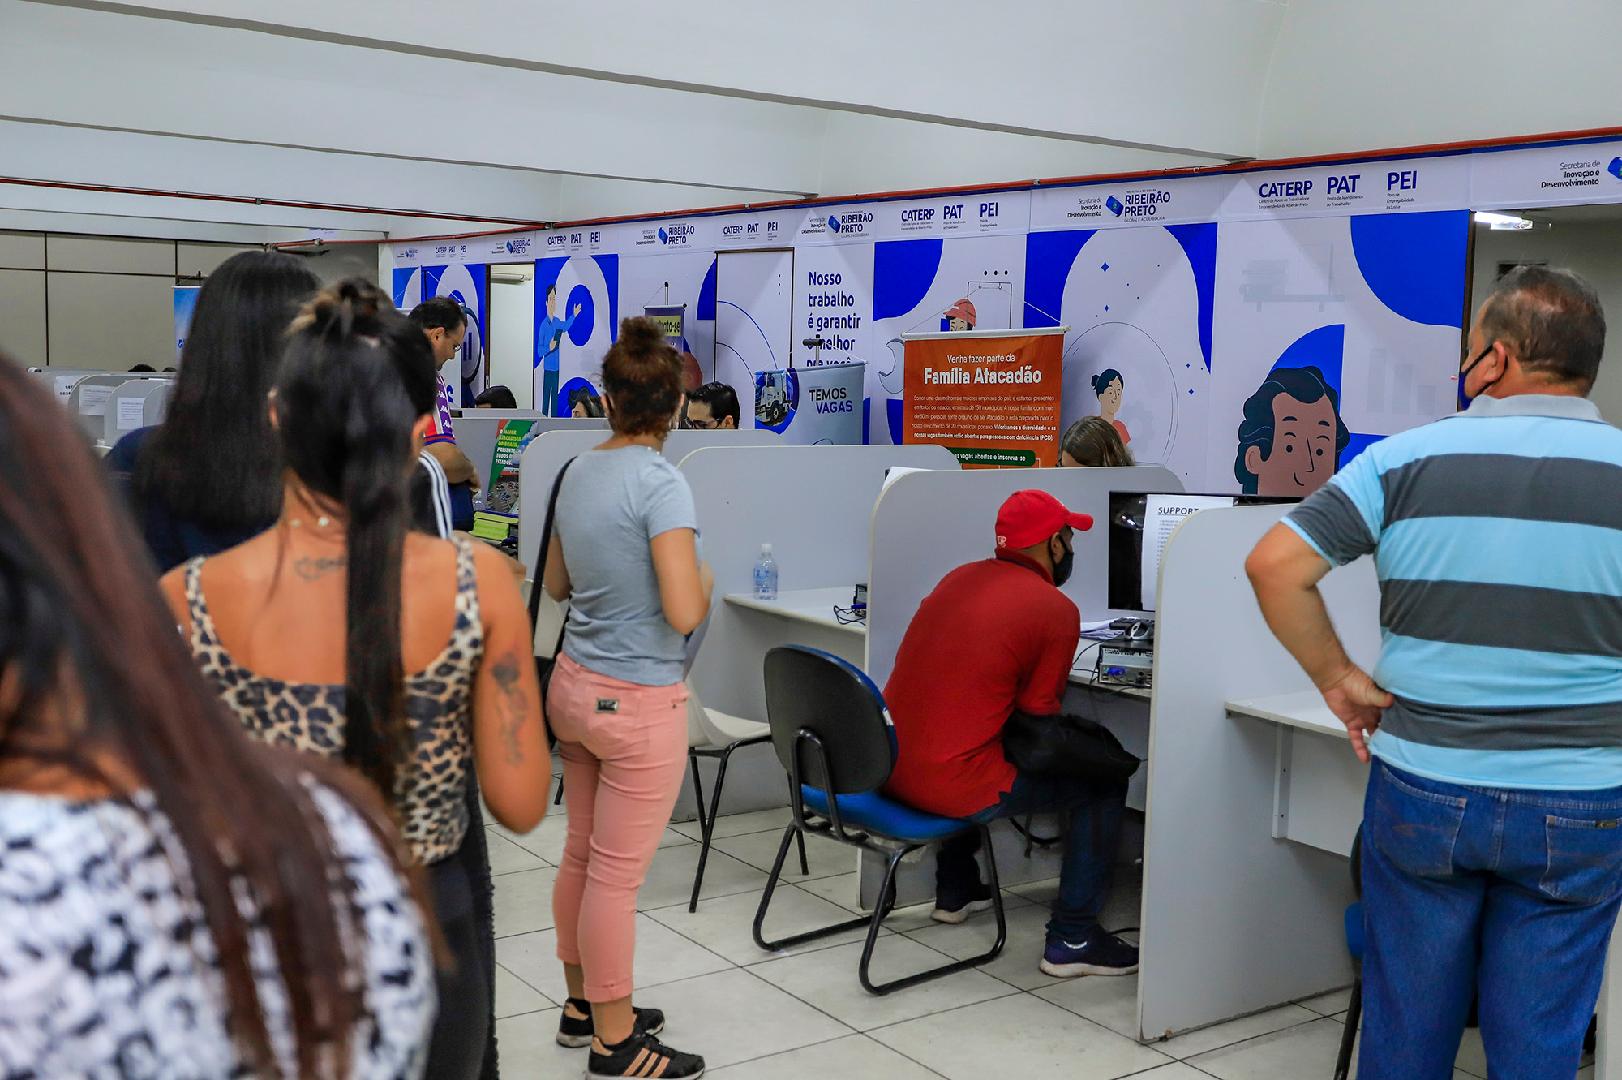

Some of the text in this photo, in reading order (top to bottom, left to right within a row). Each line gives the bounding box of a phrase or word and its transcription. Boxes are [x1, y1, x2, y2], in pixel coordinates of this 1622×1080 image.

[1564, 170, 1594, 179] Inovação
[1258, 170, 1417, 198] CATERP PAT PEI
[1125, 191, 1171, 205] RIBEIRÃO
[901, 202, 999, 222] CATERP PAT PEI
[1124, 204, 1156, 217] PRETO
[841, 212, 874, 224] RIBEIRÃO
[668, 225, 695, 236] RIBEIRÃO
[723, 221, 778, 236] CATERP PAT PEI
[841, 223, 863, 234] PRETO
[547, 231, 601, 246] CATERP PAT PEI
[668, 235, 687, 245] PRETO
[808, 271, 842, 286] Nosso
[808, 290, 855, 307] trabalho
[808, 312, 861, 332] é garantir
[947, 352, 1016, 365] Venha fazer parte da
[924, 365, 1042, 385] Família Atacadão
[809, 387, 847, 402] TEMOS
[816, 400, 853, 414] VAGAS
